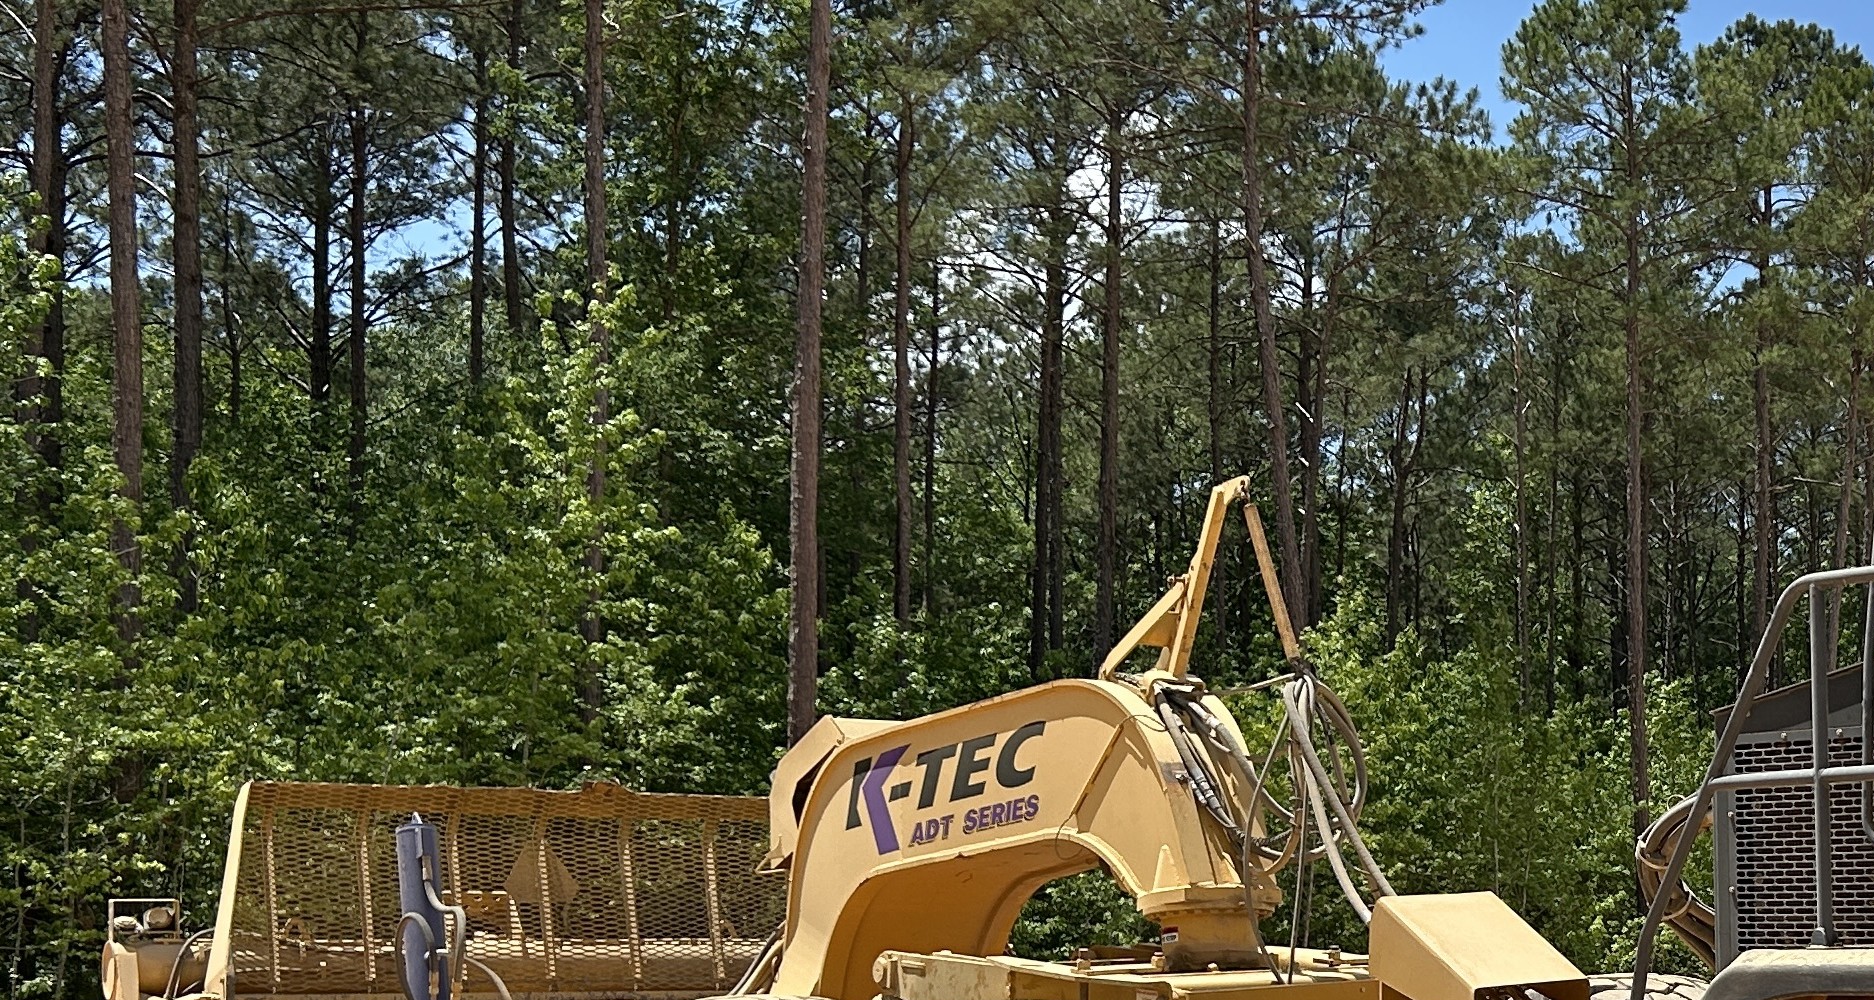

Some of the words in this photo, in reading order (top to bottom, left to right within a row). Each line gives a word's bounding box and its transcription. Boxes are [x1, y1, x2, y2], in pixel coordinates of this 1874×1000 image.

[845, 720, 1047, 856] K-TEC
[908, 814, 955, 848] ADT
[962, 794, 1040, 835] SERIES
